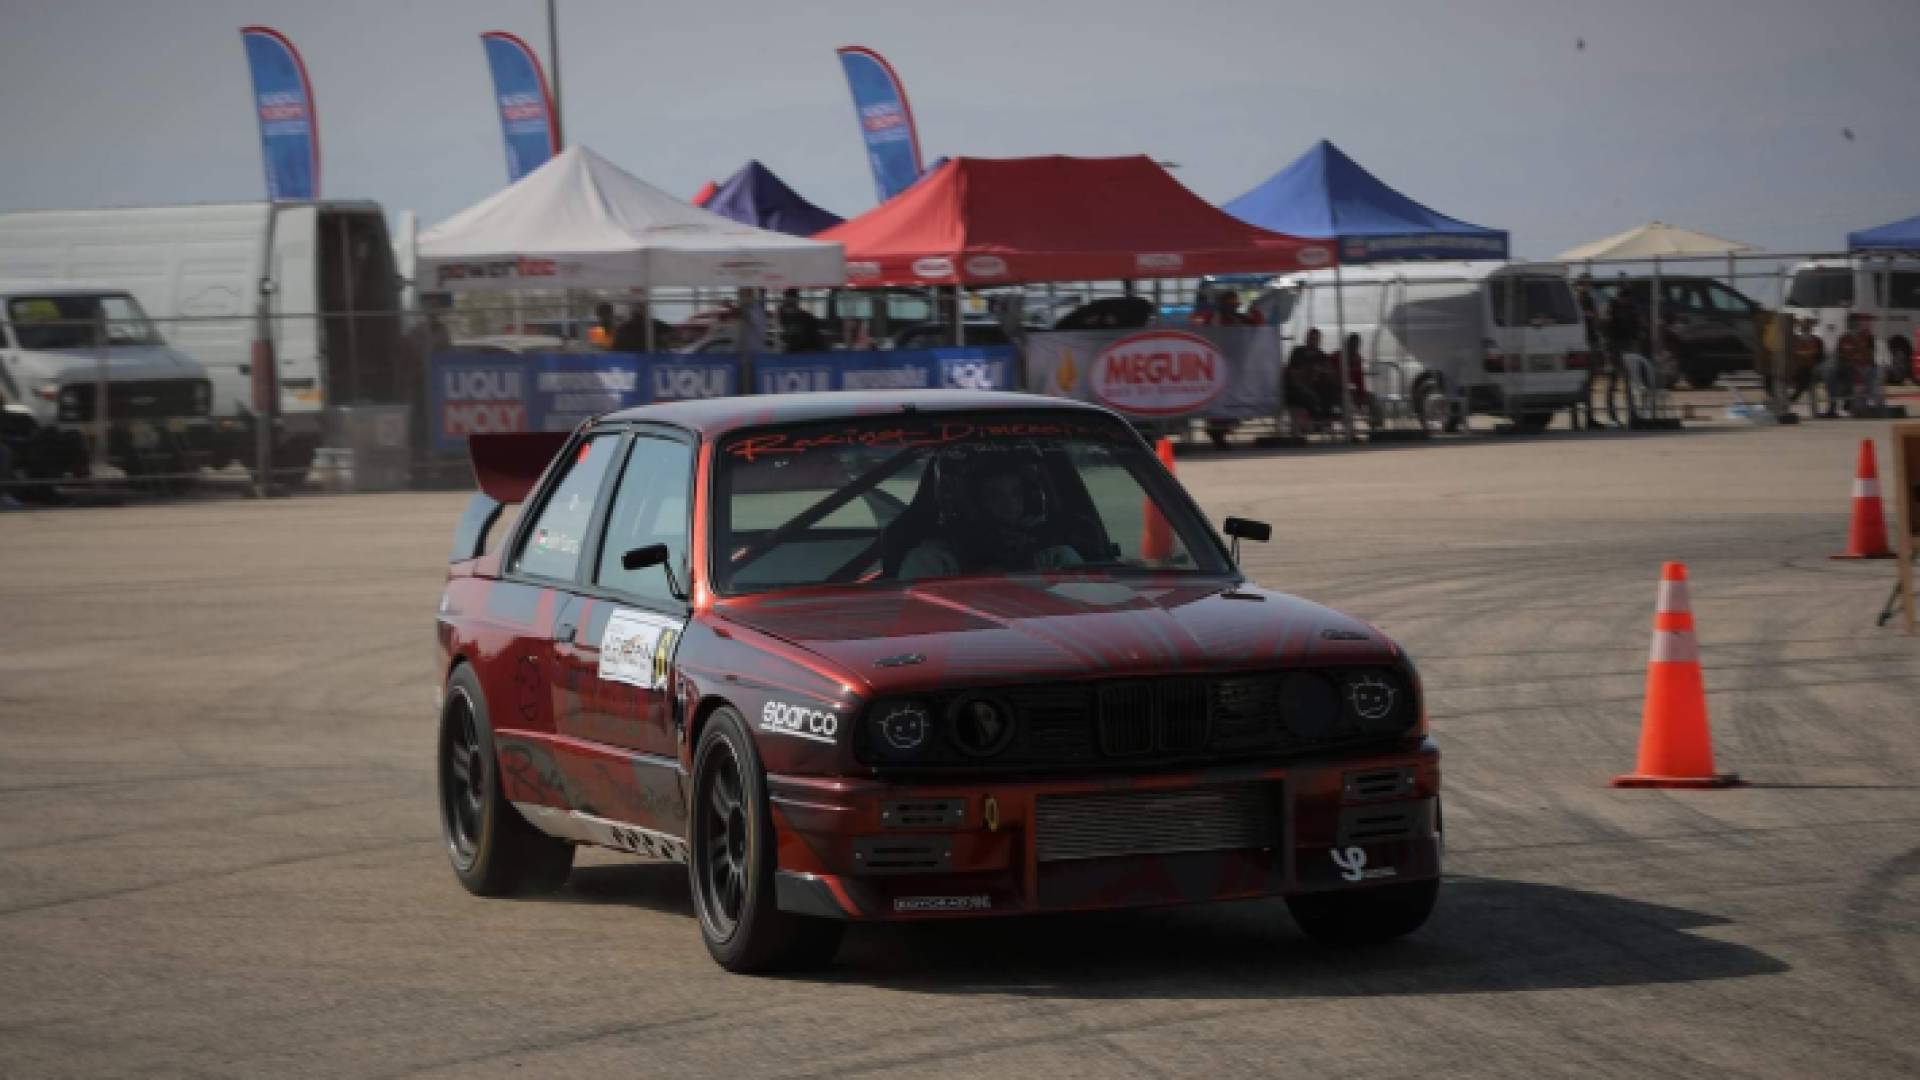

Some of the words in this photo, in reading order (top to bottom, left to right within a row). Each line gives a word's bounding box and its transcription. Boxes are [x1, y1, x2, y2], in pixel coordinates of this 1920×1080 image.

[655, 367, 725, 398] LIQUI
[1104, 352, 1216, 384] MEGUIN
[445, 371, 520, 399] LIQUI
[445, 403, 523, 432] MOLY
[762, 701, 838, 737] sparco
